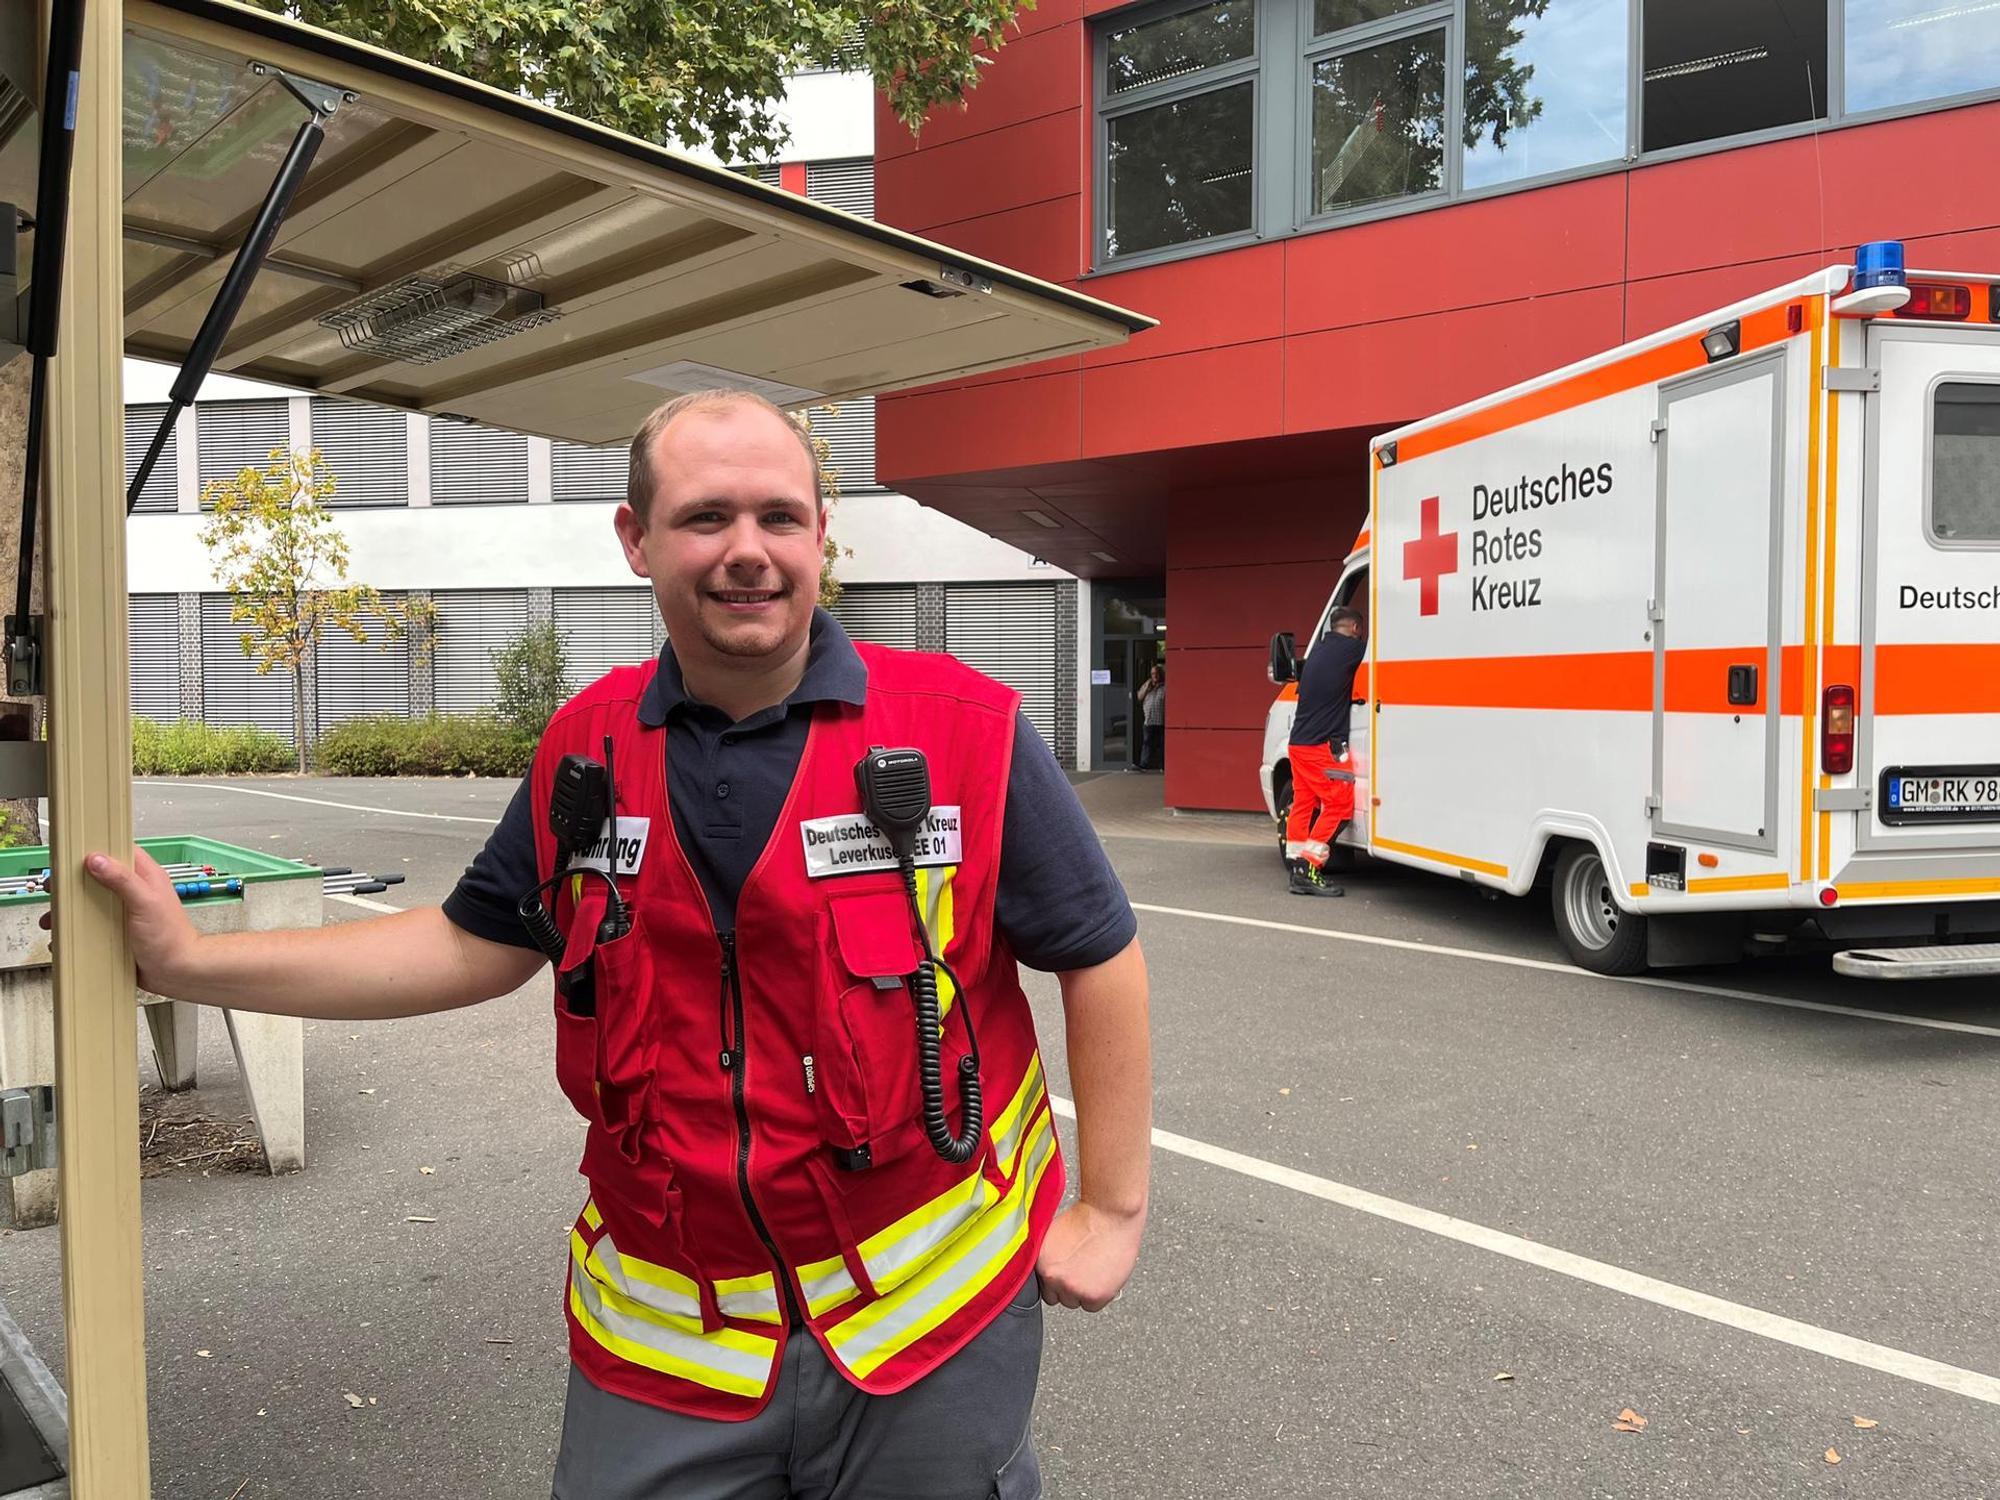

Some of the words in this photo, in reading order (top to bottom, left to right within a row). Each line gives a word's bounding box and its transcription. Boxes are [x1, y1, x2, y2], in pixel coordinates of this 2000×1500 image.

[1472, 462, 1614, 521] Deutsches
[1472, 527, 1543, 566] Rotes
[1471, 575, 1542, 611] Kreuz
[1902, 780, 1929, 802] GM
[1943, 780, 1969, 802] RK
[1974, 780, 2000, 802] 98
[806, 822, 880, 846] Deutsches
[925, 814, 958, 832] Kreuz
[829, 844, 899, 865] Leverkuse
[933, 836, 946, 854] 01
